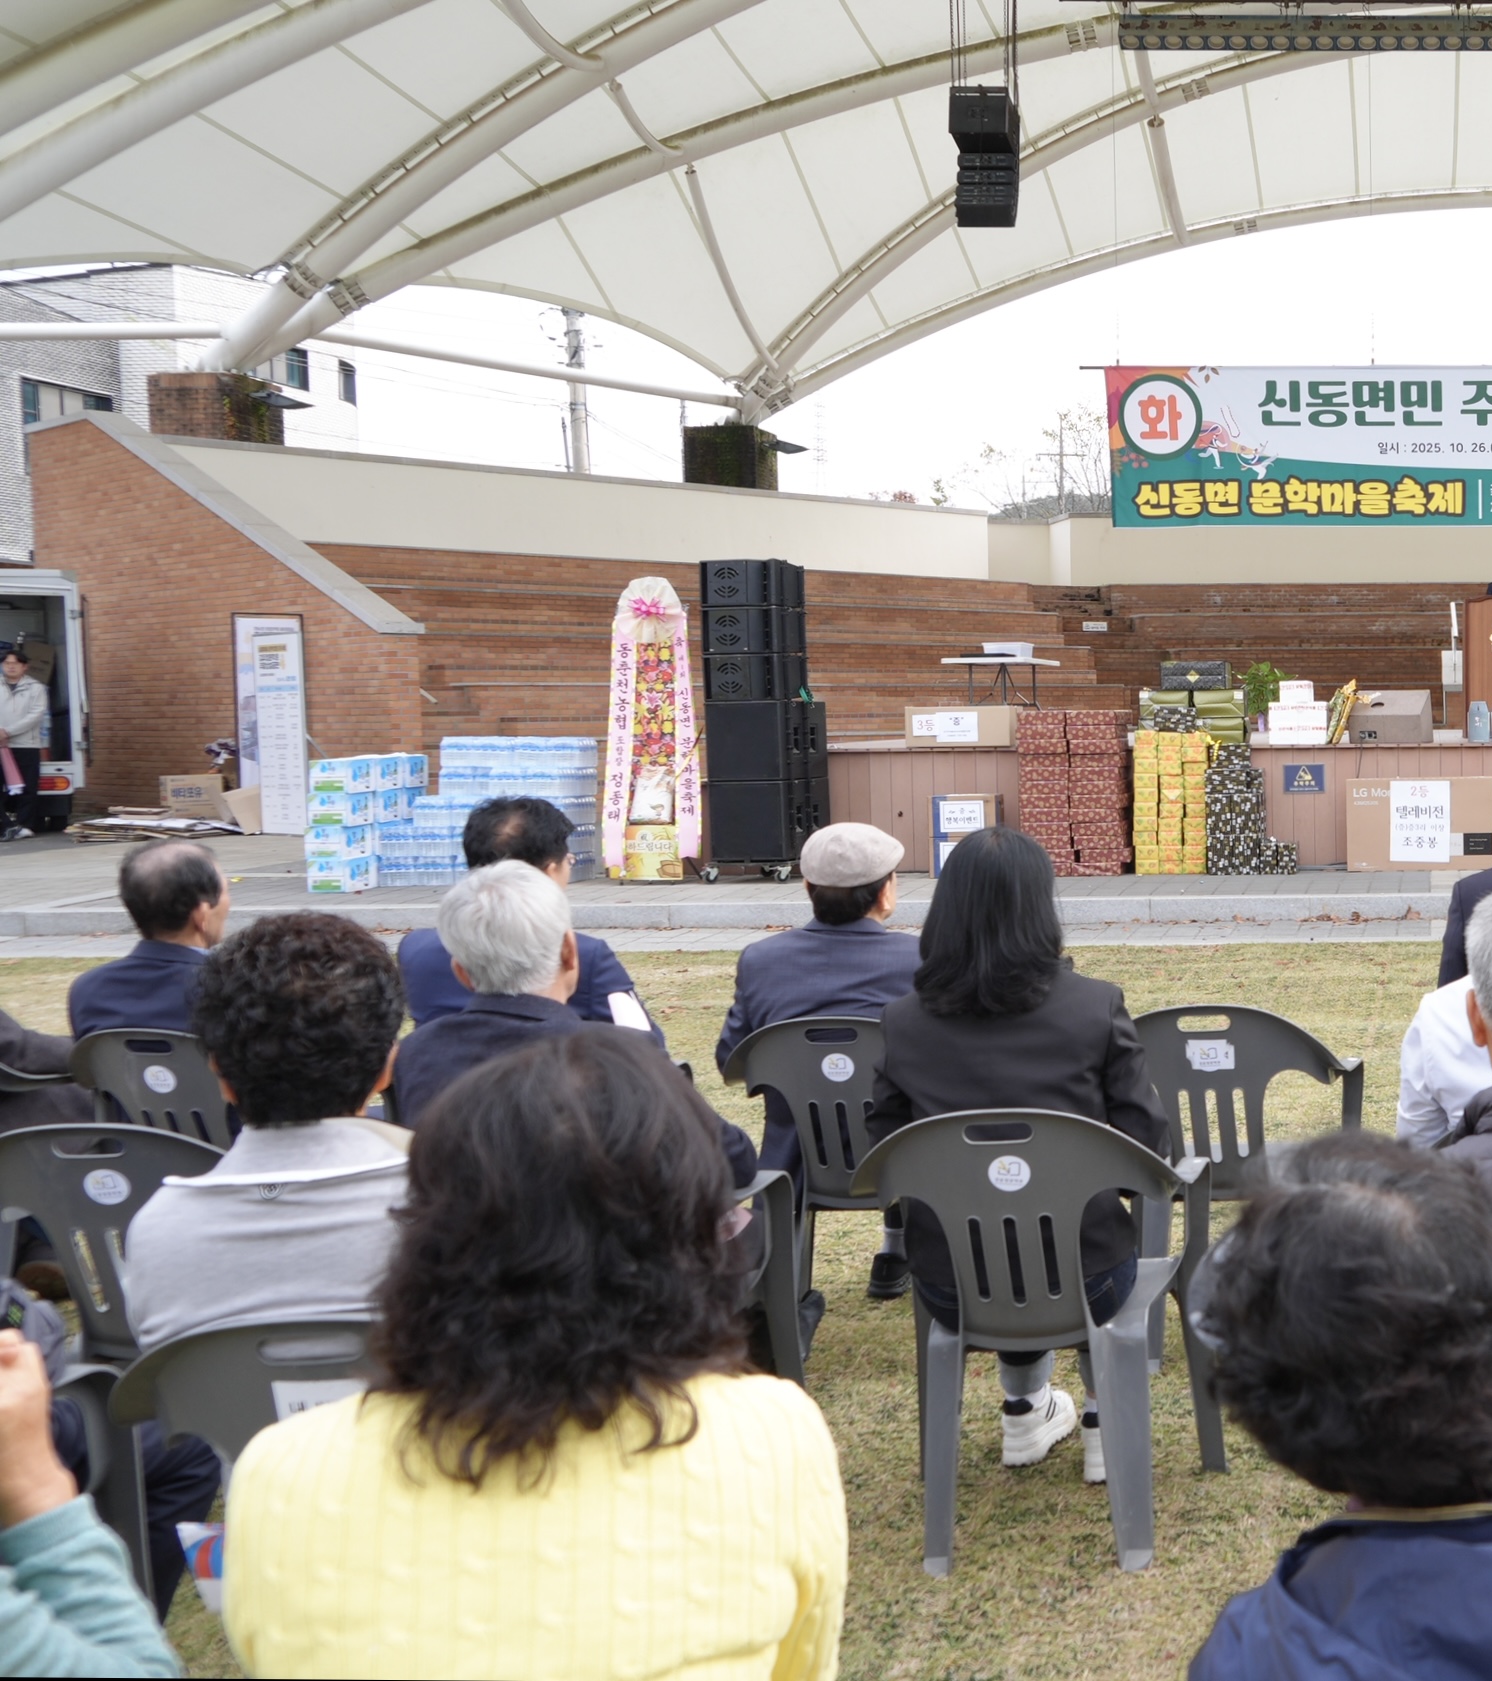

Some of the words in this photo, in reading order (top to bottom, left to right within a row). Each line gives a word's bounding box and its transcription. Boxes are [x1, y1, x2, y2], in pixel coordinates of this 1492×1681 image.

[1138, 395, 1182, 442] 화
[1257, 380, 1443, 428] 신동면민
[1377, 441, 1400, 455] 일시
[1411, 442, 1445, 454] 2025.
[1449, 442, 1468, 454] 10.
[1134, 480, 1241, 518] 신동면
[1248, 475, 1464, 517] 문학마을축제
[615, 642, 632, 731] 동춘천농협
[1353, 788, 1368, 798] LG
[1410, 786, 1430, 799] 2등
[1395, 805, 1444, 820] 텔레비전
